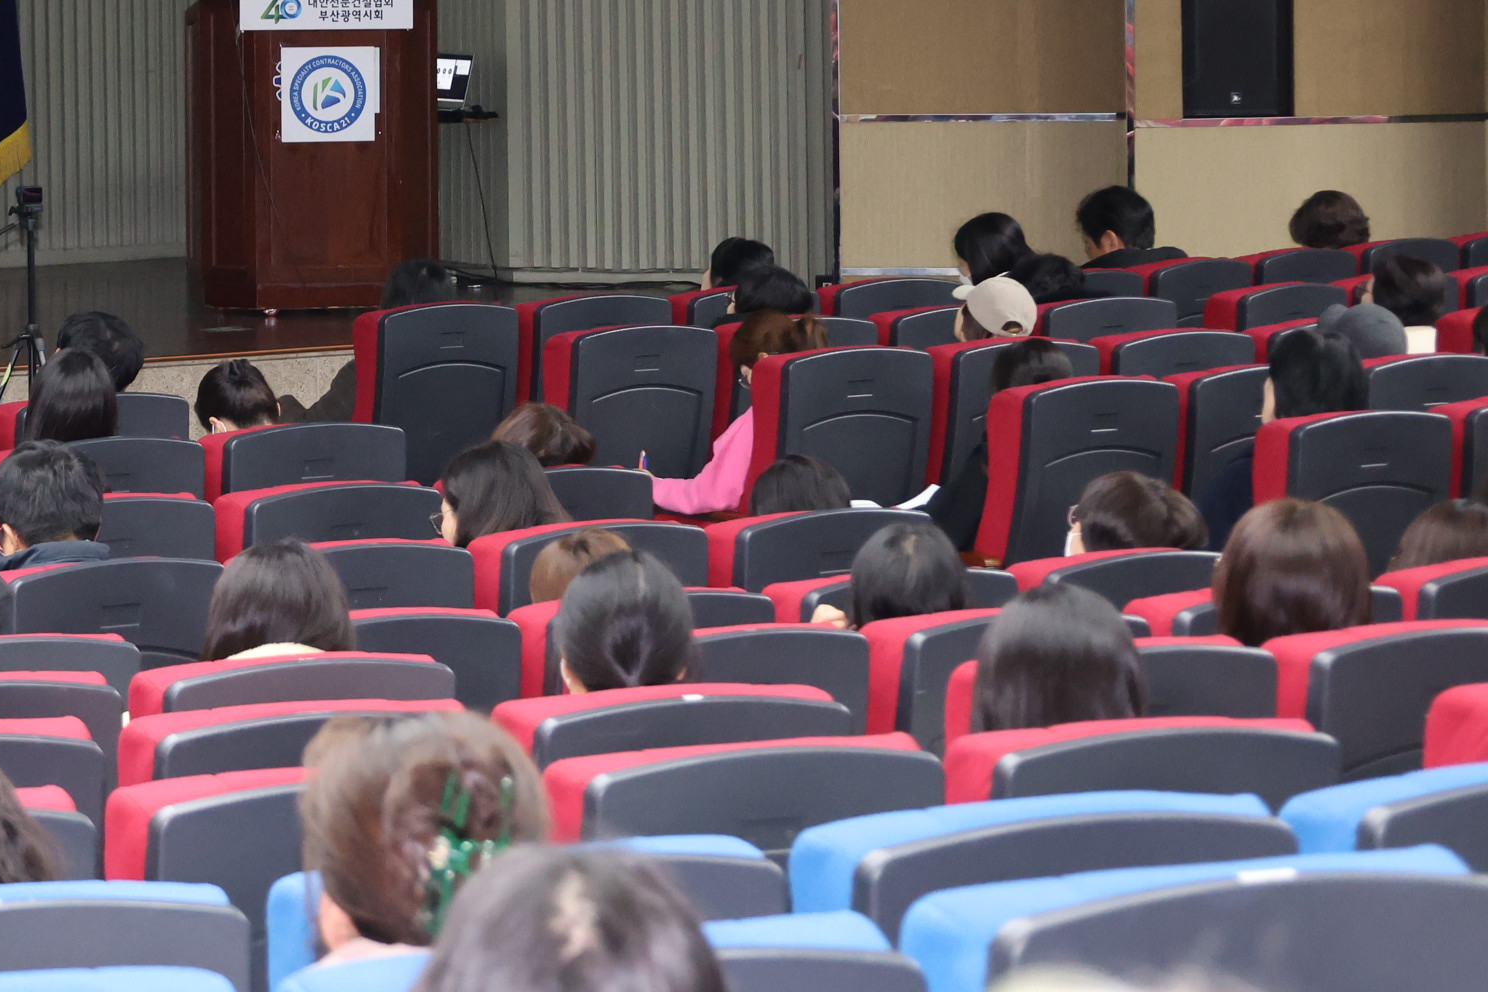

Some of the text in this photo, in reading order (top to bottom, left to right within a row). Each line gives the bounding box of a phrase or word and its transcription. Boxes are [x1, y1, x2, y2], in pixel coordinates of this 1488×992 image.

[318, 9, 384, 23] 부산광역시회
[292, 58, 364, 111] KOREA SPECIALTY CONTRACTORS ASSOCIATION
[305, 116, 351, 132] KOSCA 21
